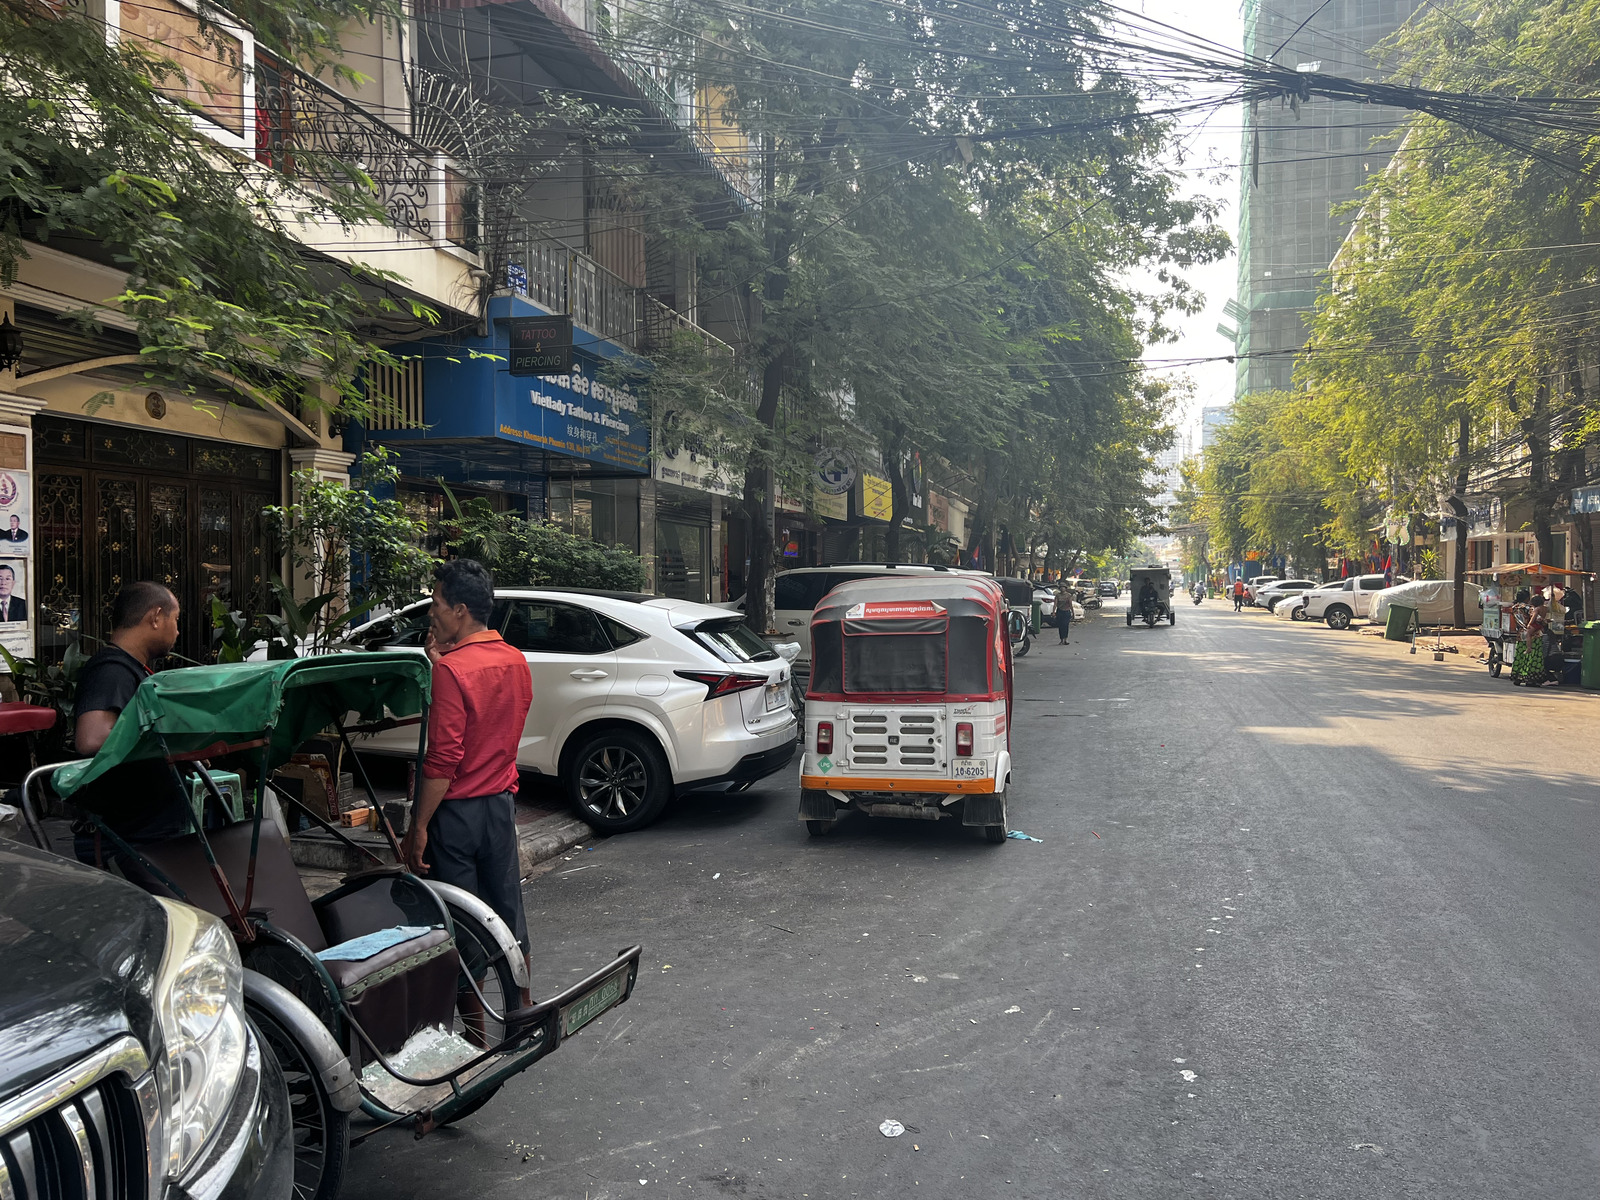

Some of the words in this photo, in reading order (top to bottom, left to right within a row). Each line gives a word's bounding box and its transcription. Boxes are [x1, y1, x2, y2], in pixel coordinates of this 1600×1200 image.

[521, 328, 557, 340] TATTOO
[535, 342, 541, 353] &
[515, 355, 561, 367] PIERCING
[567, 402, 593, 422] Tattoo
[593, 411, 600, 424] &
[600, 413, 630, 436] Piercing
[500, 424, 523, 437] Address:
